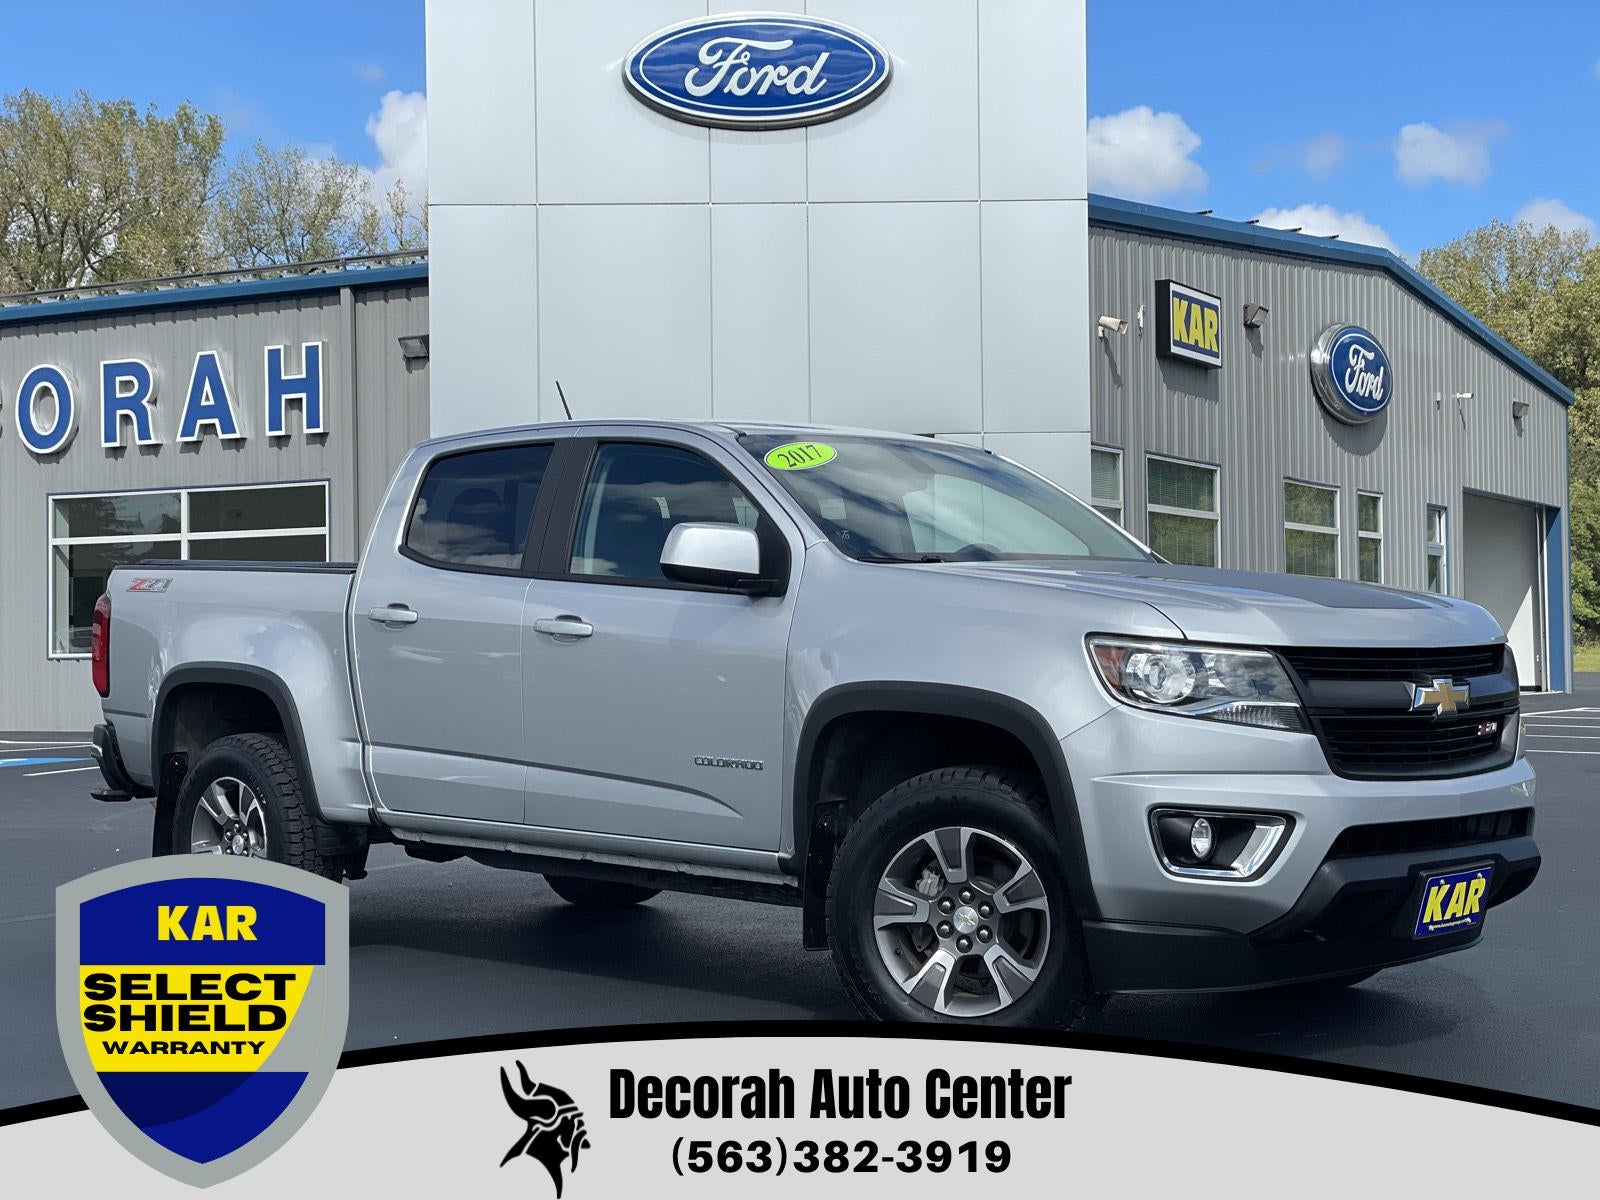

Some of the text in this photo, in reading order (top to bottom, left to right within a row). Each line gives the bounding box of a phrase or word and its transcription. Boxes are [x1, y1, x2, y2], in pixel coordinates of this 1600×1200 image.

[684, 37, 830, 97] Ford
[1172, 296, 1218, 352] KAR
[0, 341, 326, 454] ORAH
[1345, 344, 1384, 401] Ford
[777, 445, 823, 468] 2017
[694, 755, 763, 771] COLORADO
[1422, 877, 1487, 924] KAR
